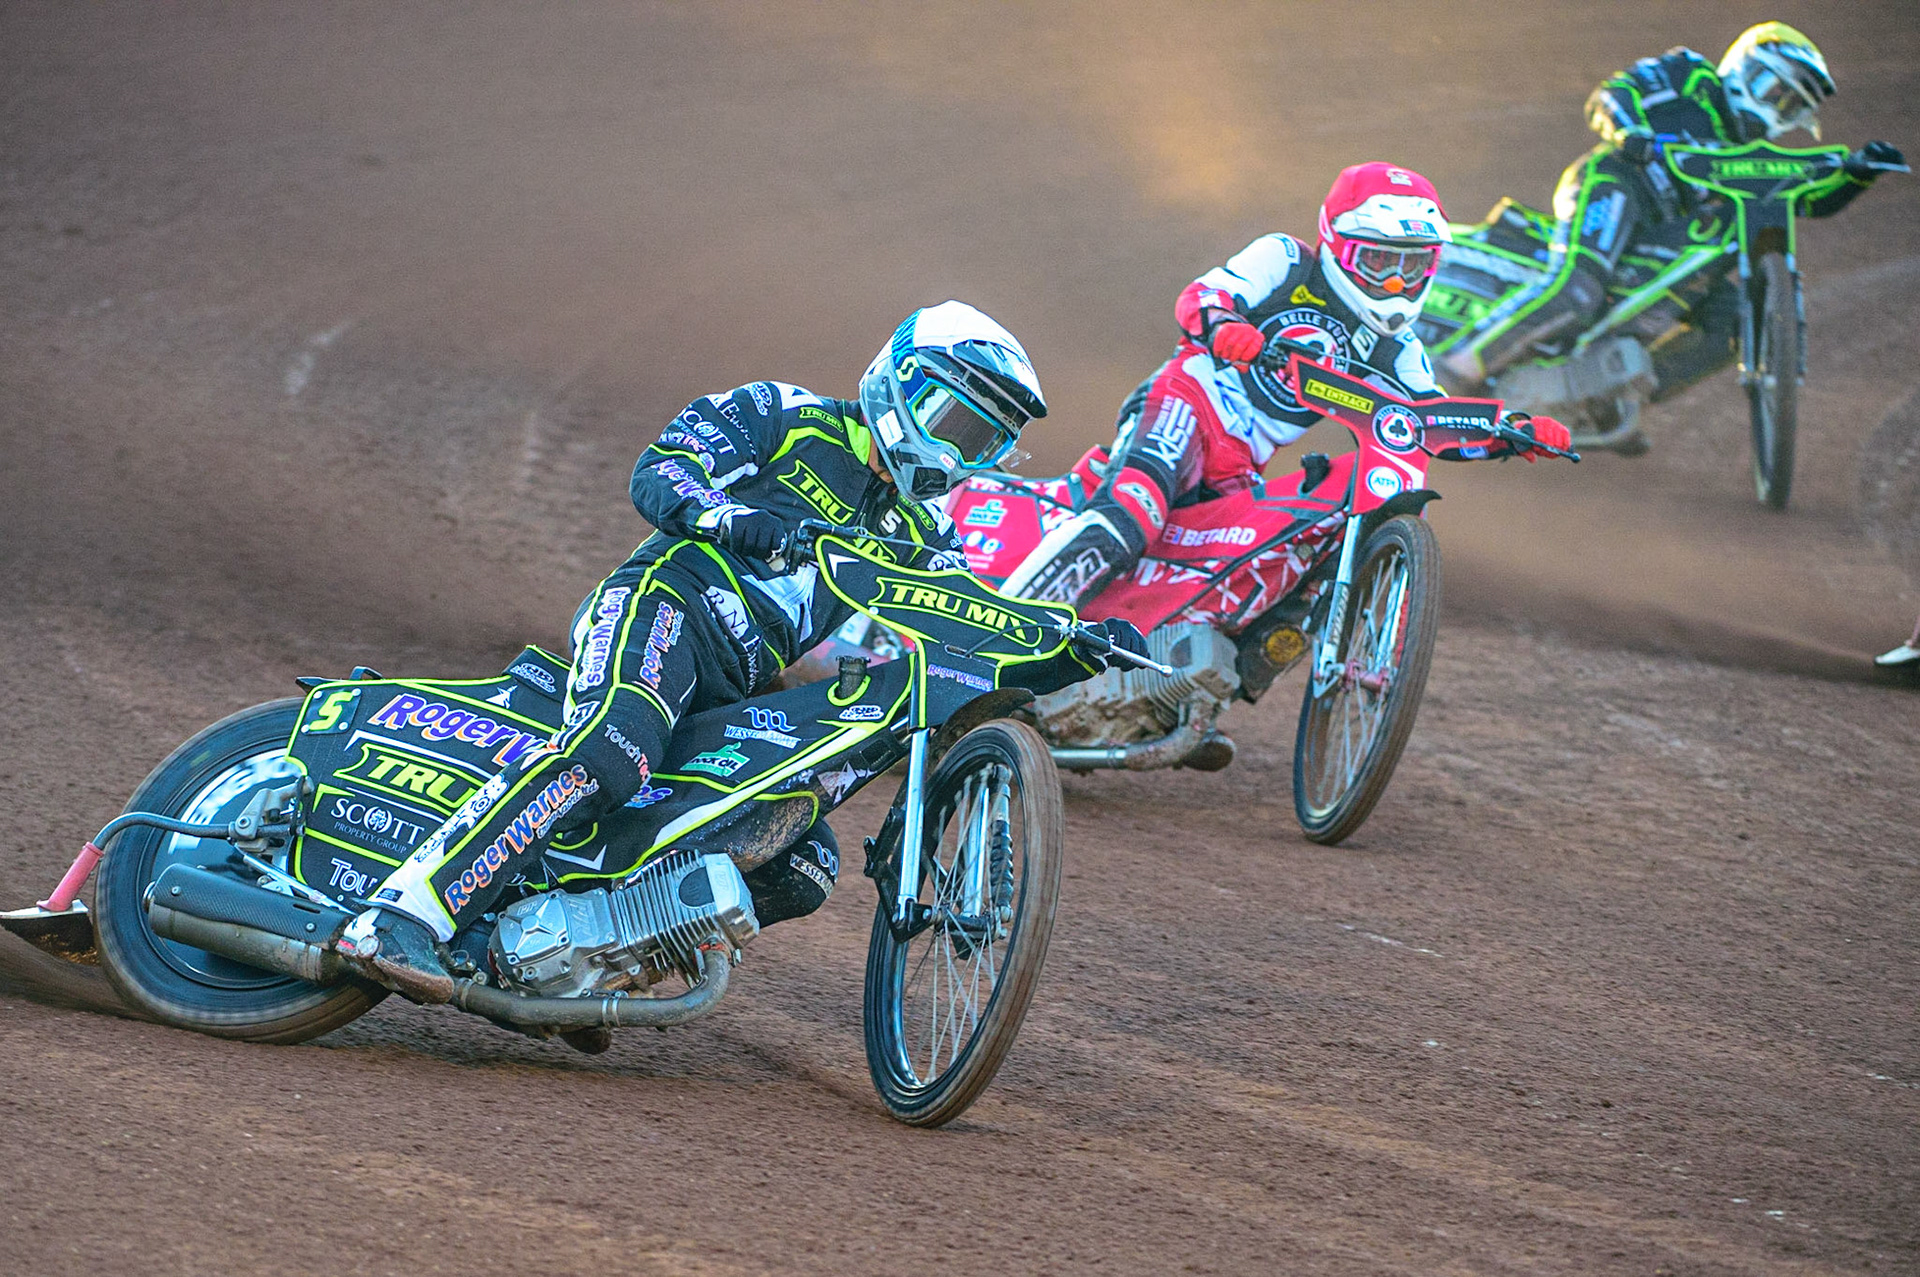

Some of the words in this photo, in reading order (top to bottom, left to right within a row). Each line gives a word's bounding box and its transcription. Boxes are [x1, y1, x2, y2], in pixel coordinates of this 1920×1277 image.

[1278, 312, 1322, 326] BELLE
[799, 473, 853, 524] TRU
[1180, 526, 1256, 546] BETARD
[891, 583, 964, 617] TRU
[964, 600, 1028, 639] MIX
[366, 754, 479, 808] TRU
[331, 797, 425, 845] SCOTT
[333, 821, 378, 845] PROPERTY
[377, 835, 407, 855] GROUP
